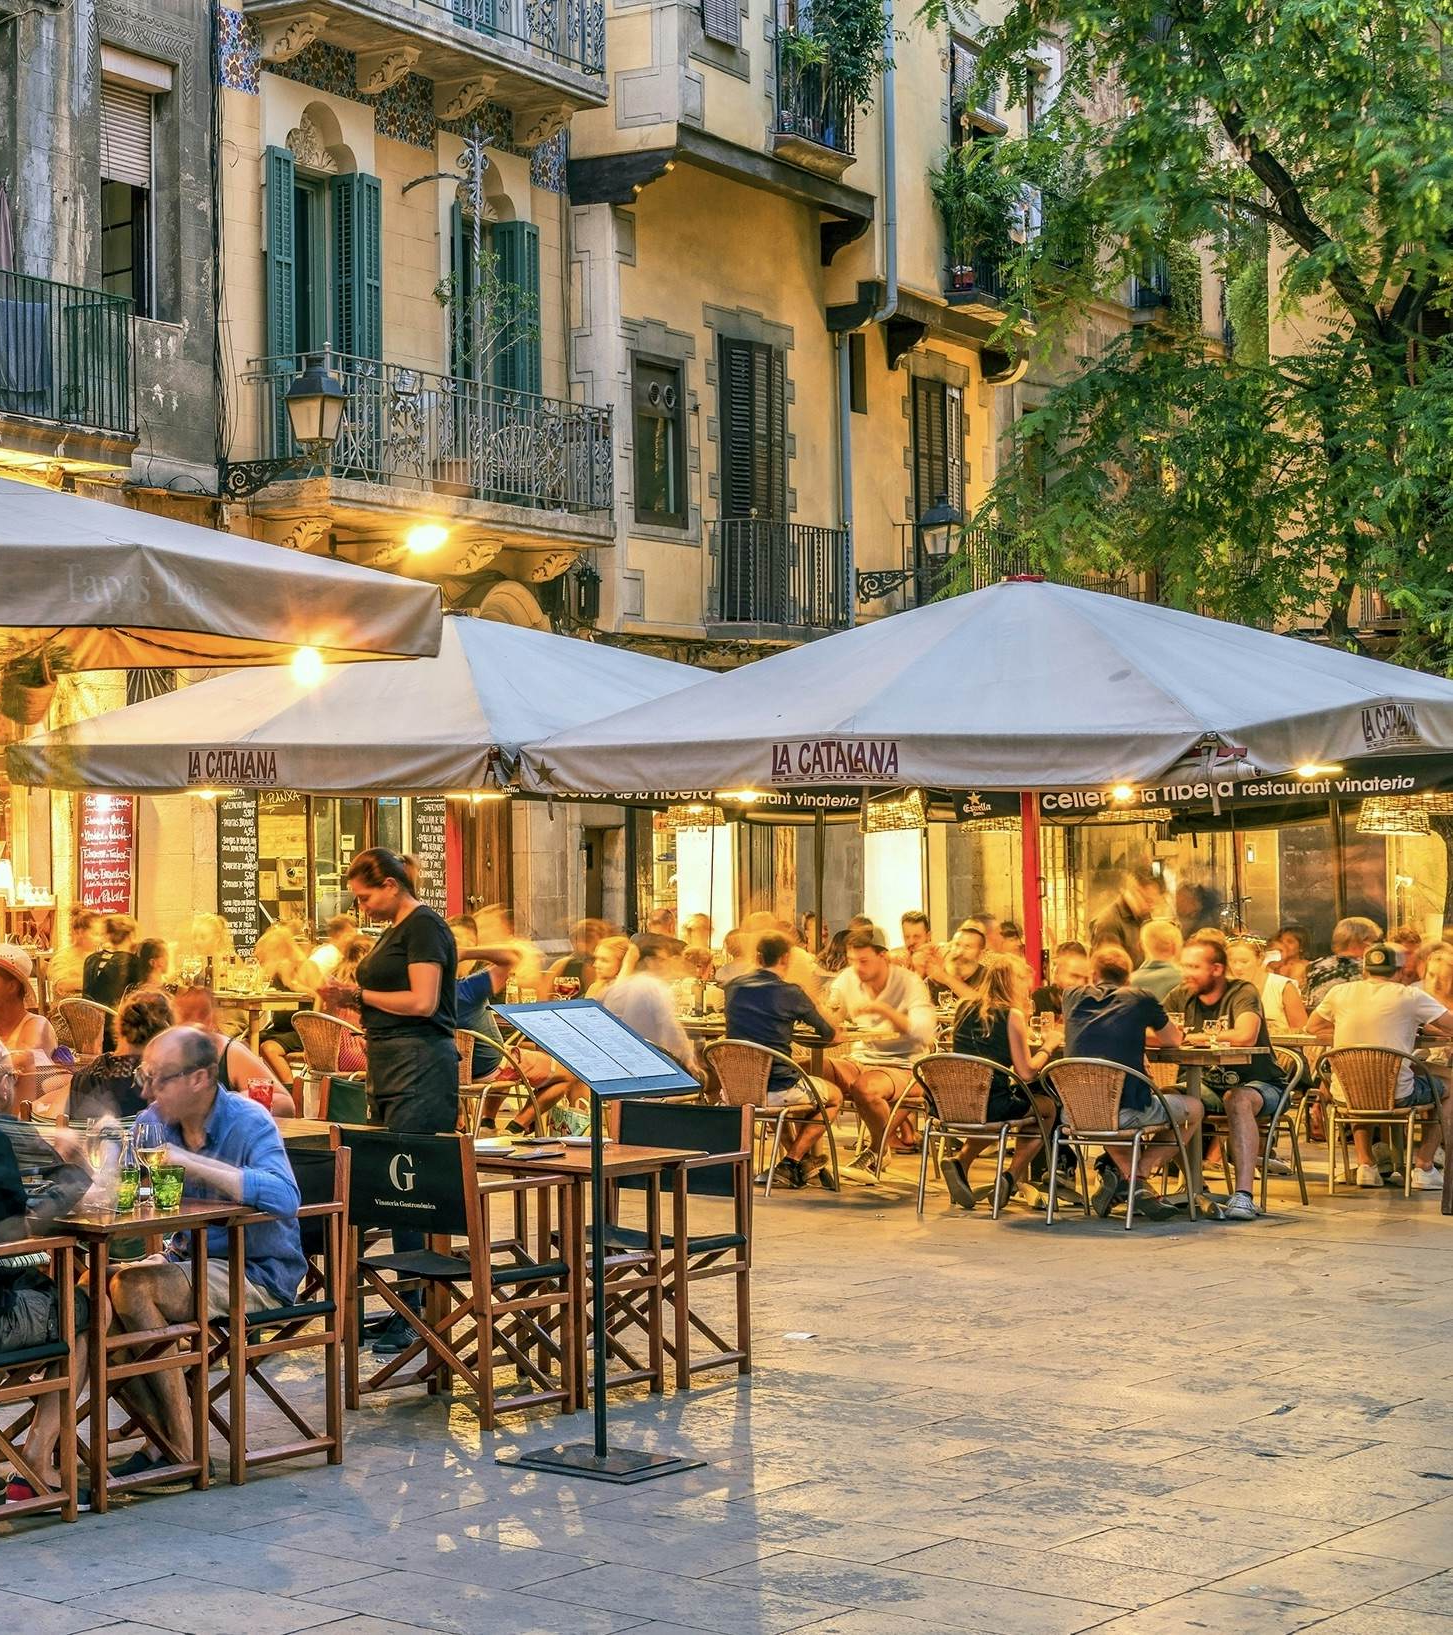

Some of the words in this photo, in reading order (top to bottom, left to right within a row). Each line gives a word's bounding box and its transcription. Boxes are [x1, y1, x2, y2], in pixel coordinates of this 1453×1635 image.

[66, 562, 150, 613] Tapas
[1361, 709, 1376, 742] LA
[188, 751, 201, 778] LA
[205, 751, 277, 779] CATALANA
[771, 743, 792, 776] LA
[797, 741, 899, 775] CATALANA
[795, 793, 859, 806] vinateria
[1242, 778, 1330, 797] restaurant
[1335, 775, 1415, 792] vinateria
[389, 1153, 416, 1192] G
